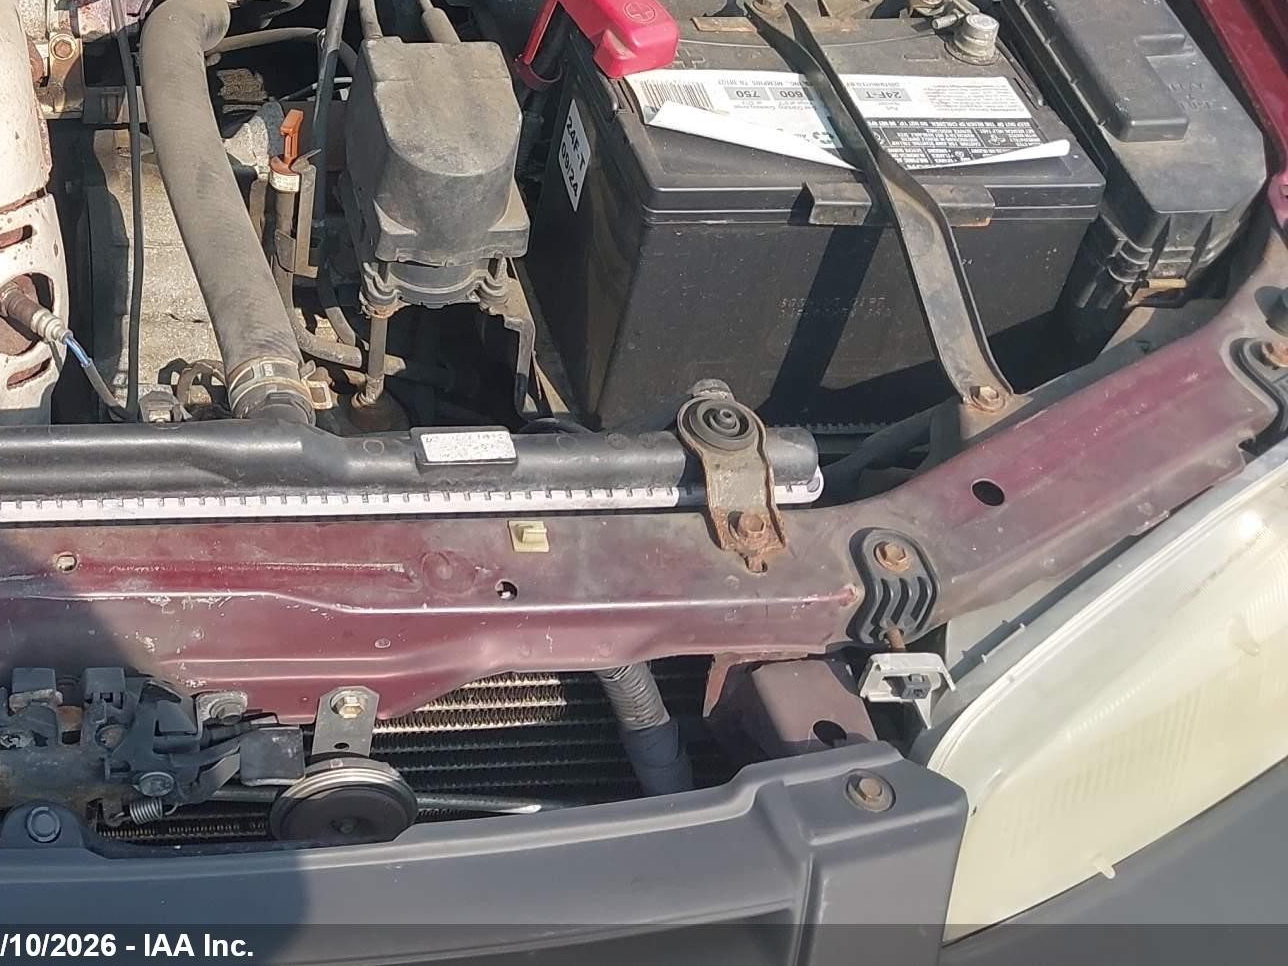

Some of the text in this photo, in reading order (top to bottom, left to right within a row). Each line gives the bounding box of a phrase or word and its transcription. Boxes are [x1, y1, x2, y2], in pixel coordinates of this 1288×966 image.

[735, 90, 761, 98] 750
[779, 90, 804, 98] 600
[865, 91, 902, 99] 24F-T
[566, 115, 586, 171] 24F-T
[561, 141, 579, 197] 09/24
